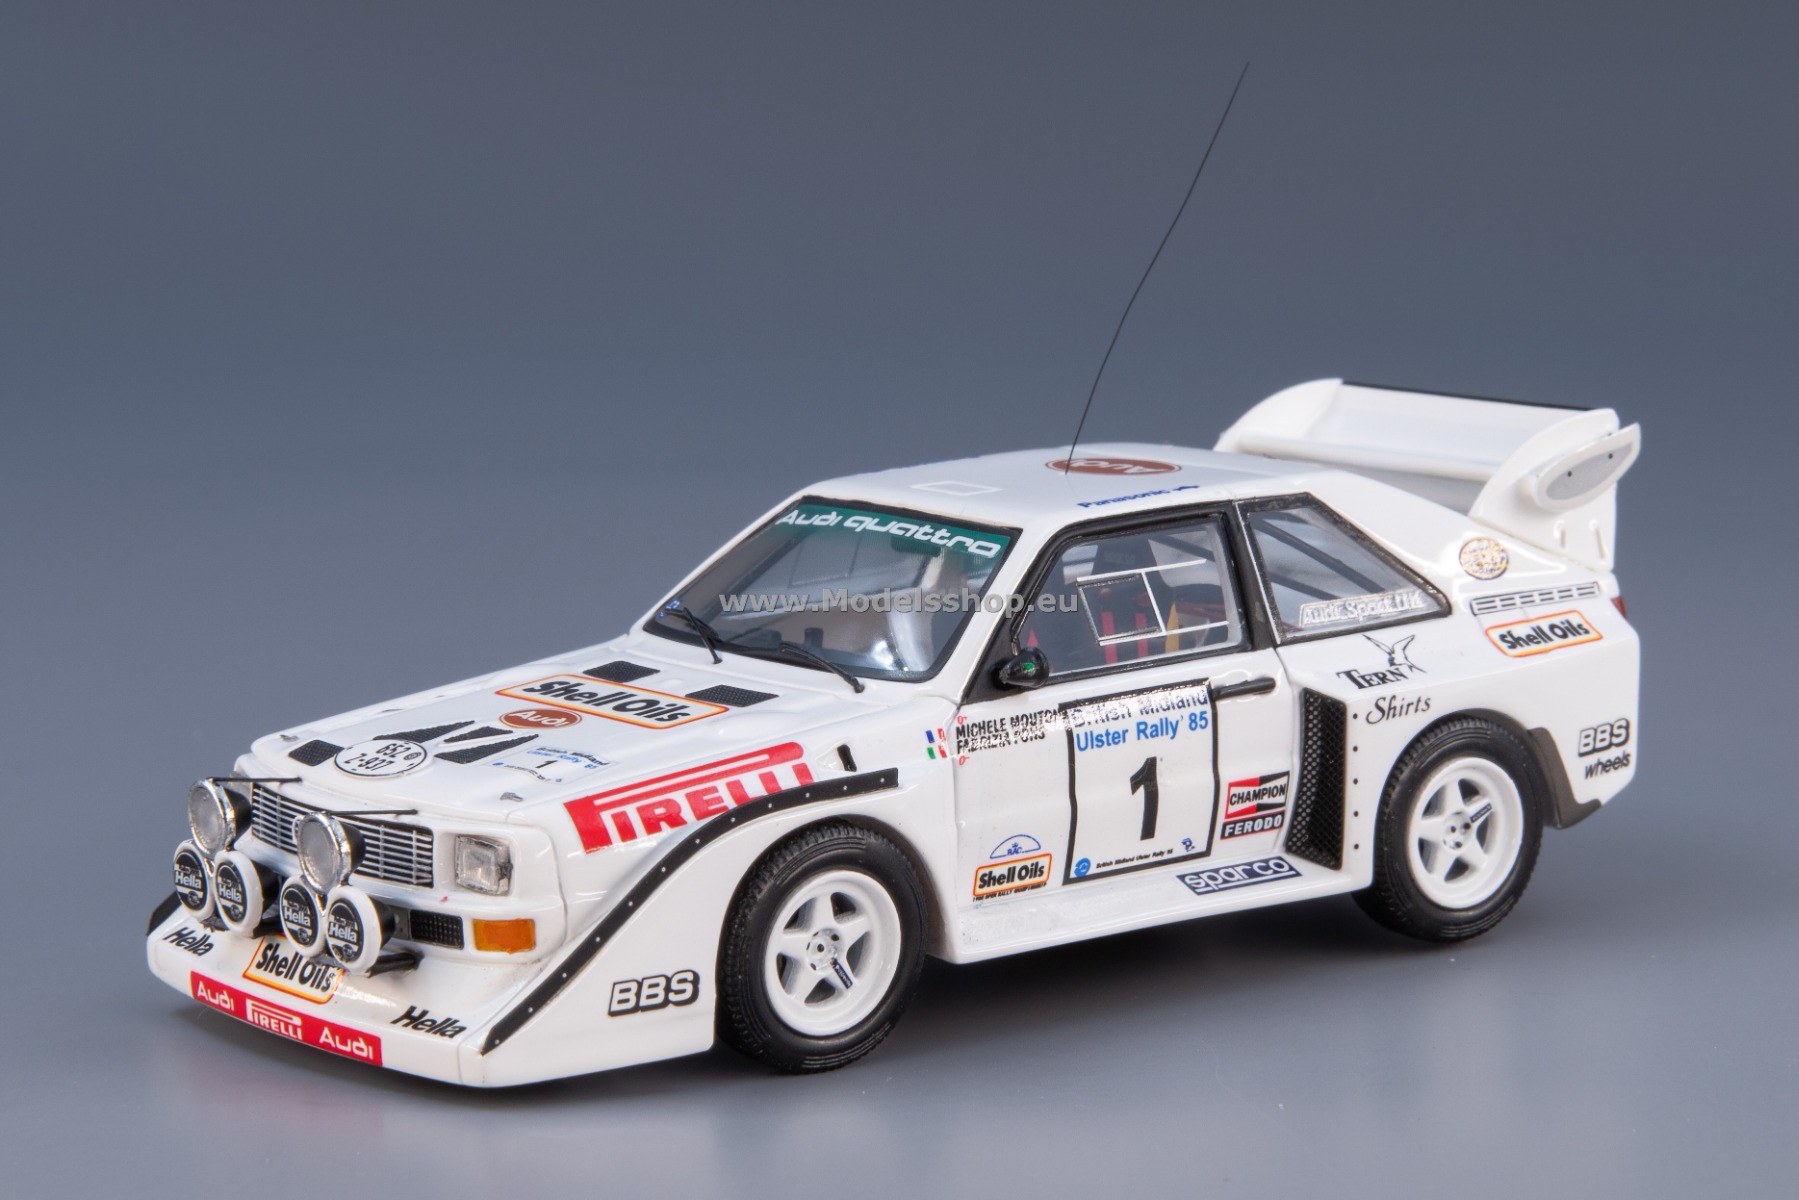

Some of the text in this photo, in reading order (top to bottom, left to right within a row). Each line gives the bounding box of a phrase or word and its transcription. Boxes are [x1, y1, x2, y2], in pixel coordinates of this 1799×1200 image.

[1077, 490, 1170, 508] Panasonic
[775, 509, 1001, 559] Audi quattro
[1499, 619, 1590, 650] Shell Oils
[1336, 667, 1410, 690] TERN
[523, 680, 691, 723] Shell Oils
[1366, 695, 1431, 725] Shirts
[508, 711, 572, 728] Audi
[956, 717, 1007, 740] MICHELE
[1076, 729, 1129, 752] Ulster
[1578, 718, 1630, 757] BBS
[1585, 750, 1631, 780] wheels
[563, 741, 815, 855] PIRELLI
[1130, 757, 1159, 841] 1
[1228, 781, 1287, 806] CHAMPION
[1224, 814, 1283, 838] FERODO
[175, 870, 202, 889] Hella
[978, 865, 1016, 889] Shell
[1017, 861, 1045, 881] Oils
[1183, 859, 1291, 891] sparco
[219, 883, 242, 902] Hella
[284, 905, 311, 927] Hella
[163, 926, 215, 957] Hella
[329, 921, 357, 943] Hella
[256, 942, 304, 981] Shell
[608, 969, 700, 1018] BBS
[197, 980, 373, 1060] Audi PIRELLI Audi
[390, 1005, 468, 1039] Hella
